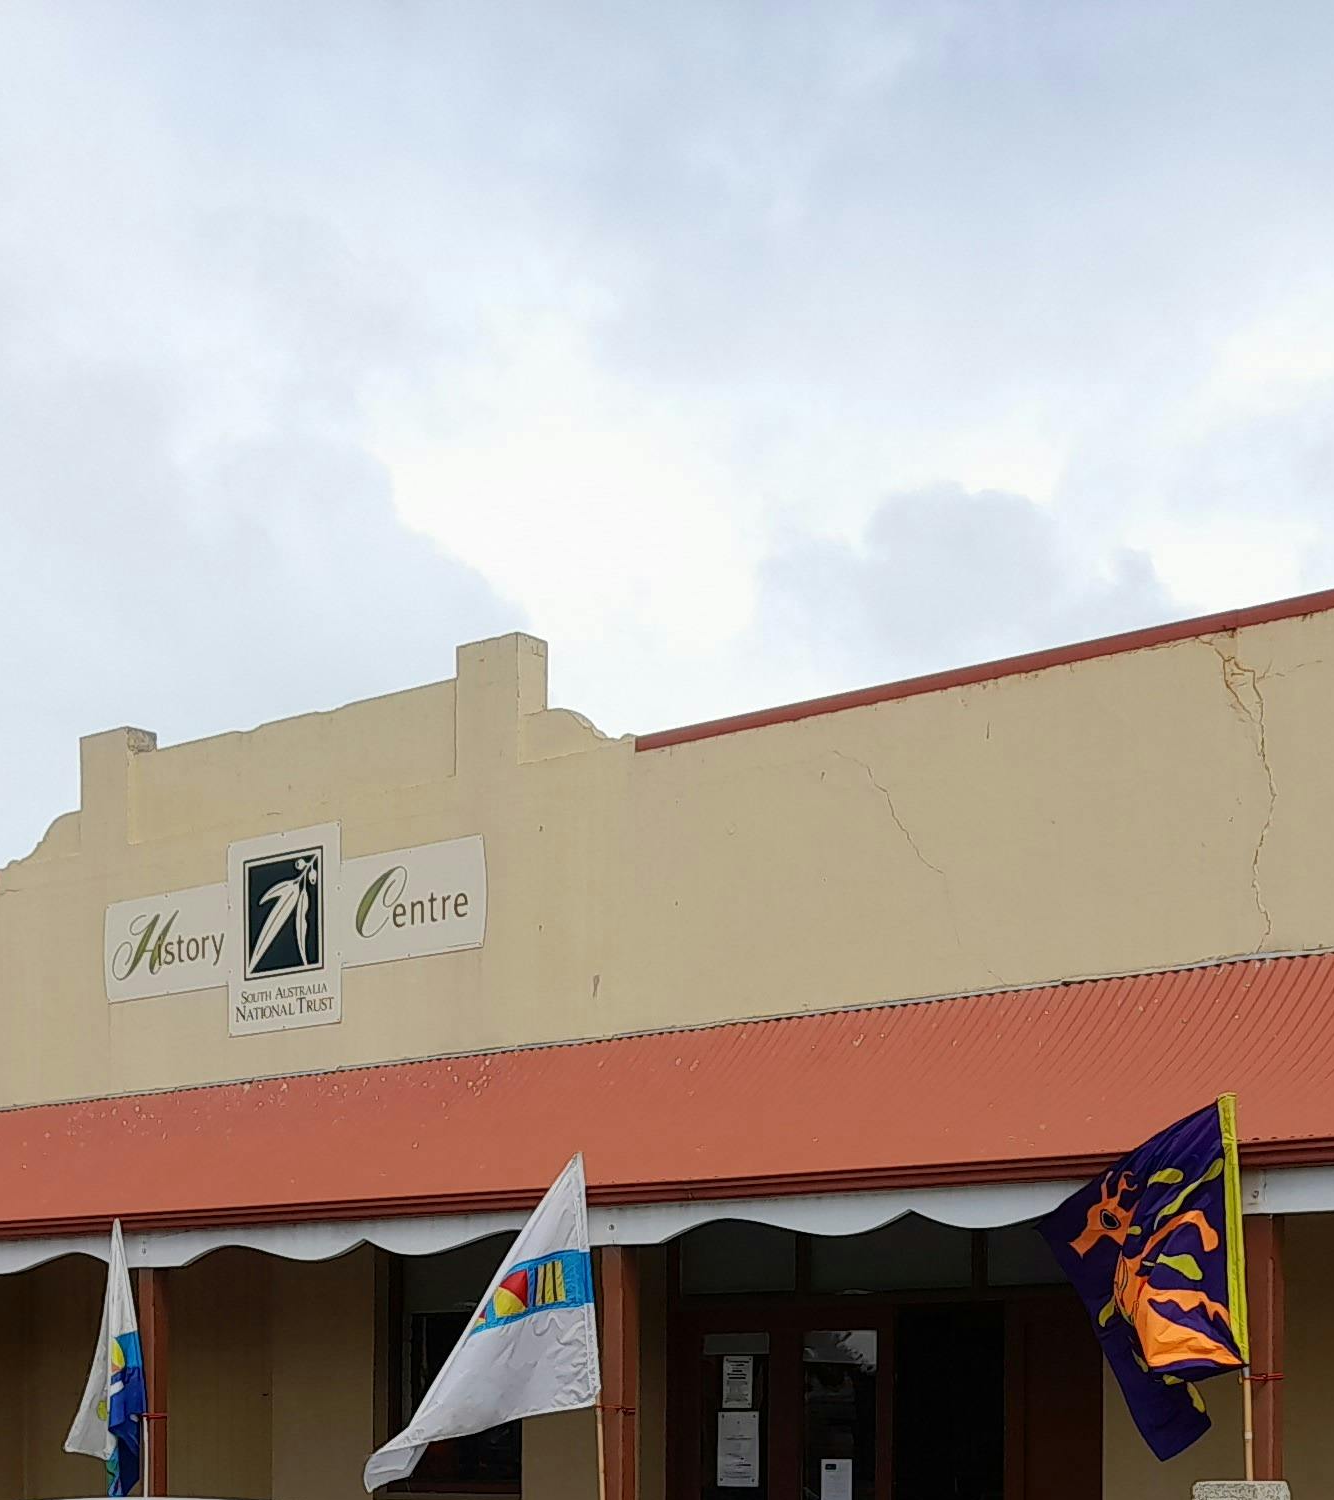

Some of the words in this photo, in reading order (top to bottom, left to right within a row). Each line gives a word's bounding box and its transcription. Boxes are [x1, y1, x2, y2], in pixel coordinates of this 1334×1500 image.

[113, 909, 225, 981] History
[355, 865, 468, 938] Centre
[241, 990, 272, 1005] SOUTH
[275, 982, 328, 1000] AUSTRALIA
[235, 1001, 296, 1023] NATIONAL
[296, 996, 335, 1014] TRUST
